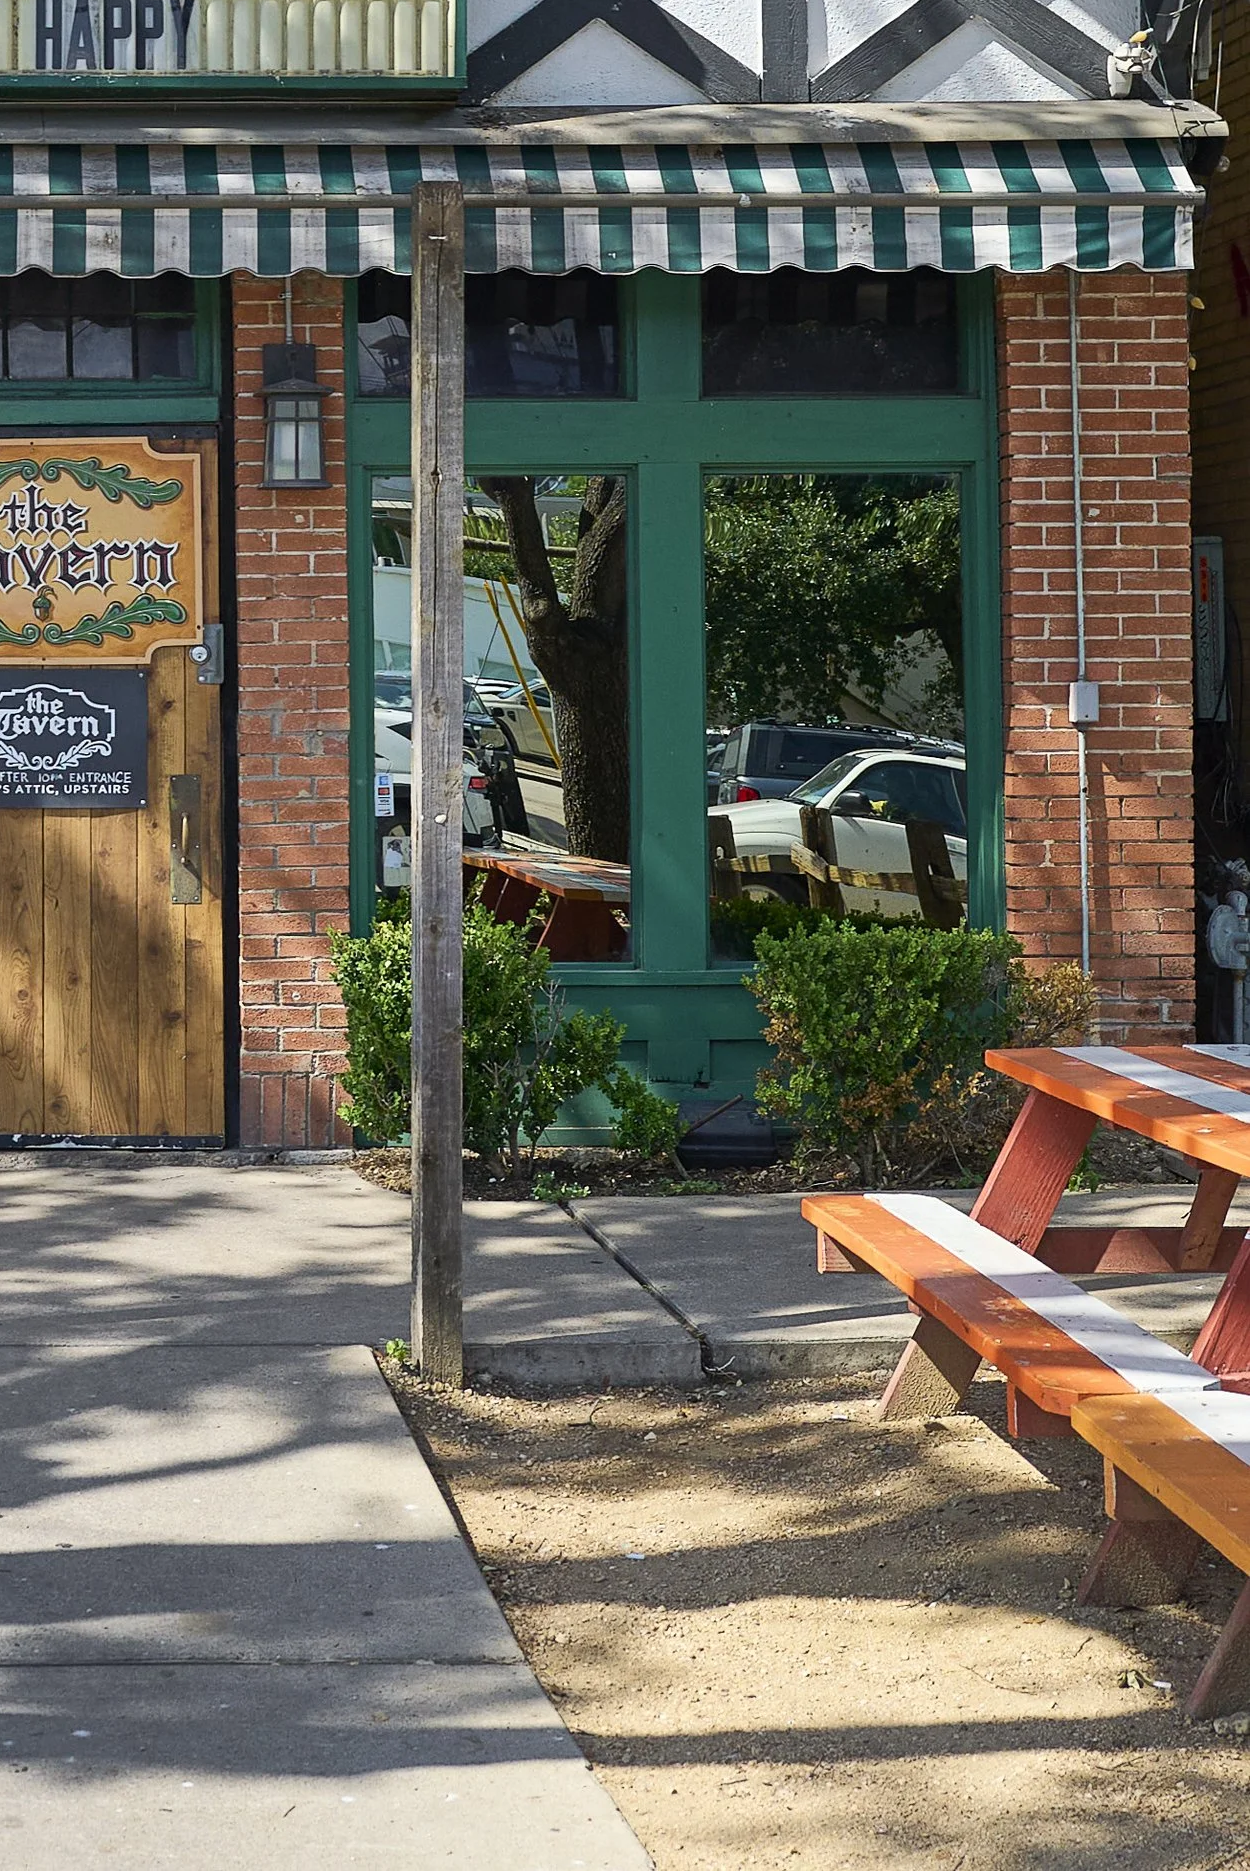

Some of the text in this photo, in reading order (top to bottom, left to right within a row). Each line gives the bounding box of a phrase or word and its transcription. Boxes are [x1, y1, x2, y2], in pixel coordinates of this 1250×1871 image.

[25, 691, 65, 715] the
[69, 771, 132, 784] ENTRANCE
[15, 784, 59, 796] ATTIC,
[64, 784, 130, 794] UPSTAIRS
